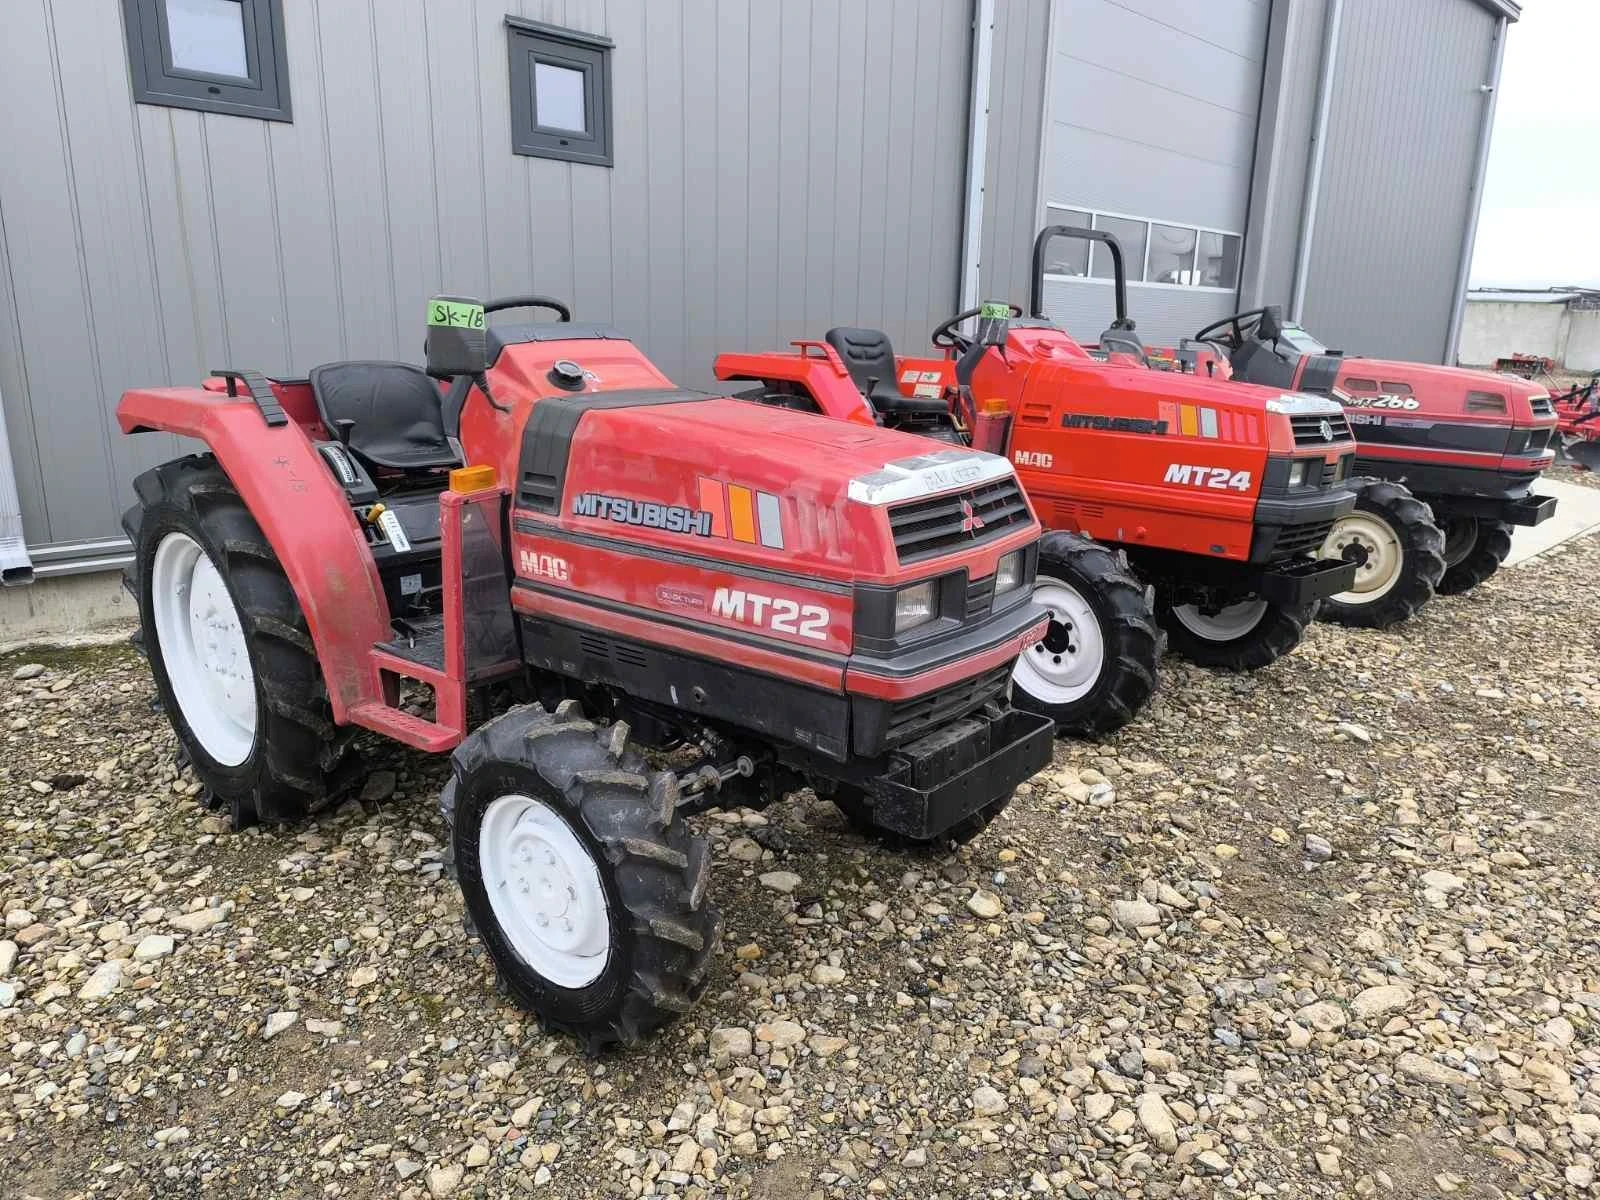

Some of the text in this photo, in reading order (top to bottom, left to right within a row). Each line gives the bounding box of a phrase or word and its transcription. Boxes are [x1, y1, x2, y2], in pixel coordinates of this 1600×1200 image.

[1164, 463, 1252, 492] MT24
[572, 492, 713, 537] MITSUBISHI
[712, 587, 831, 641] MT22
